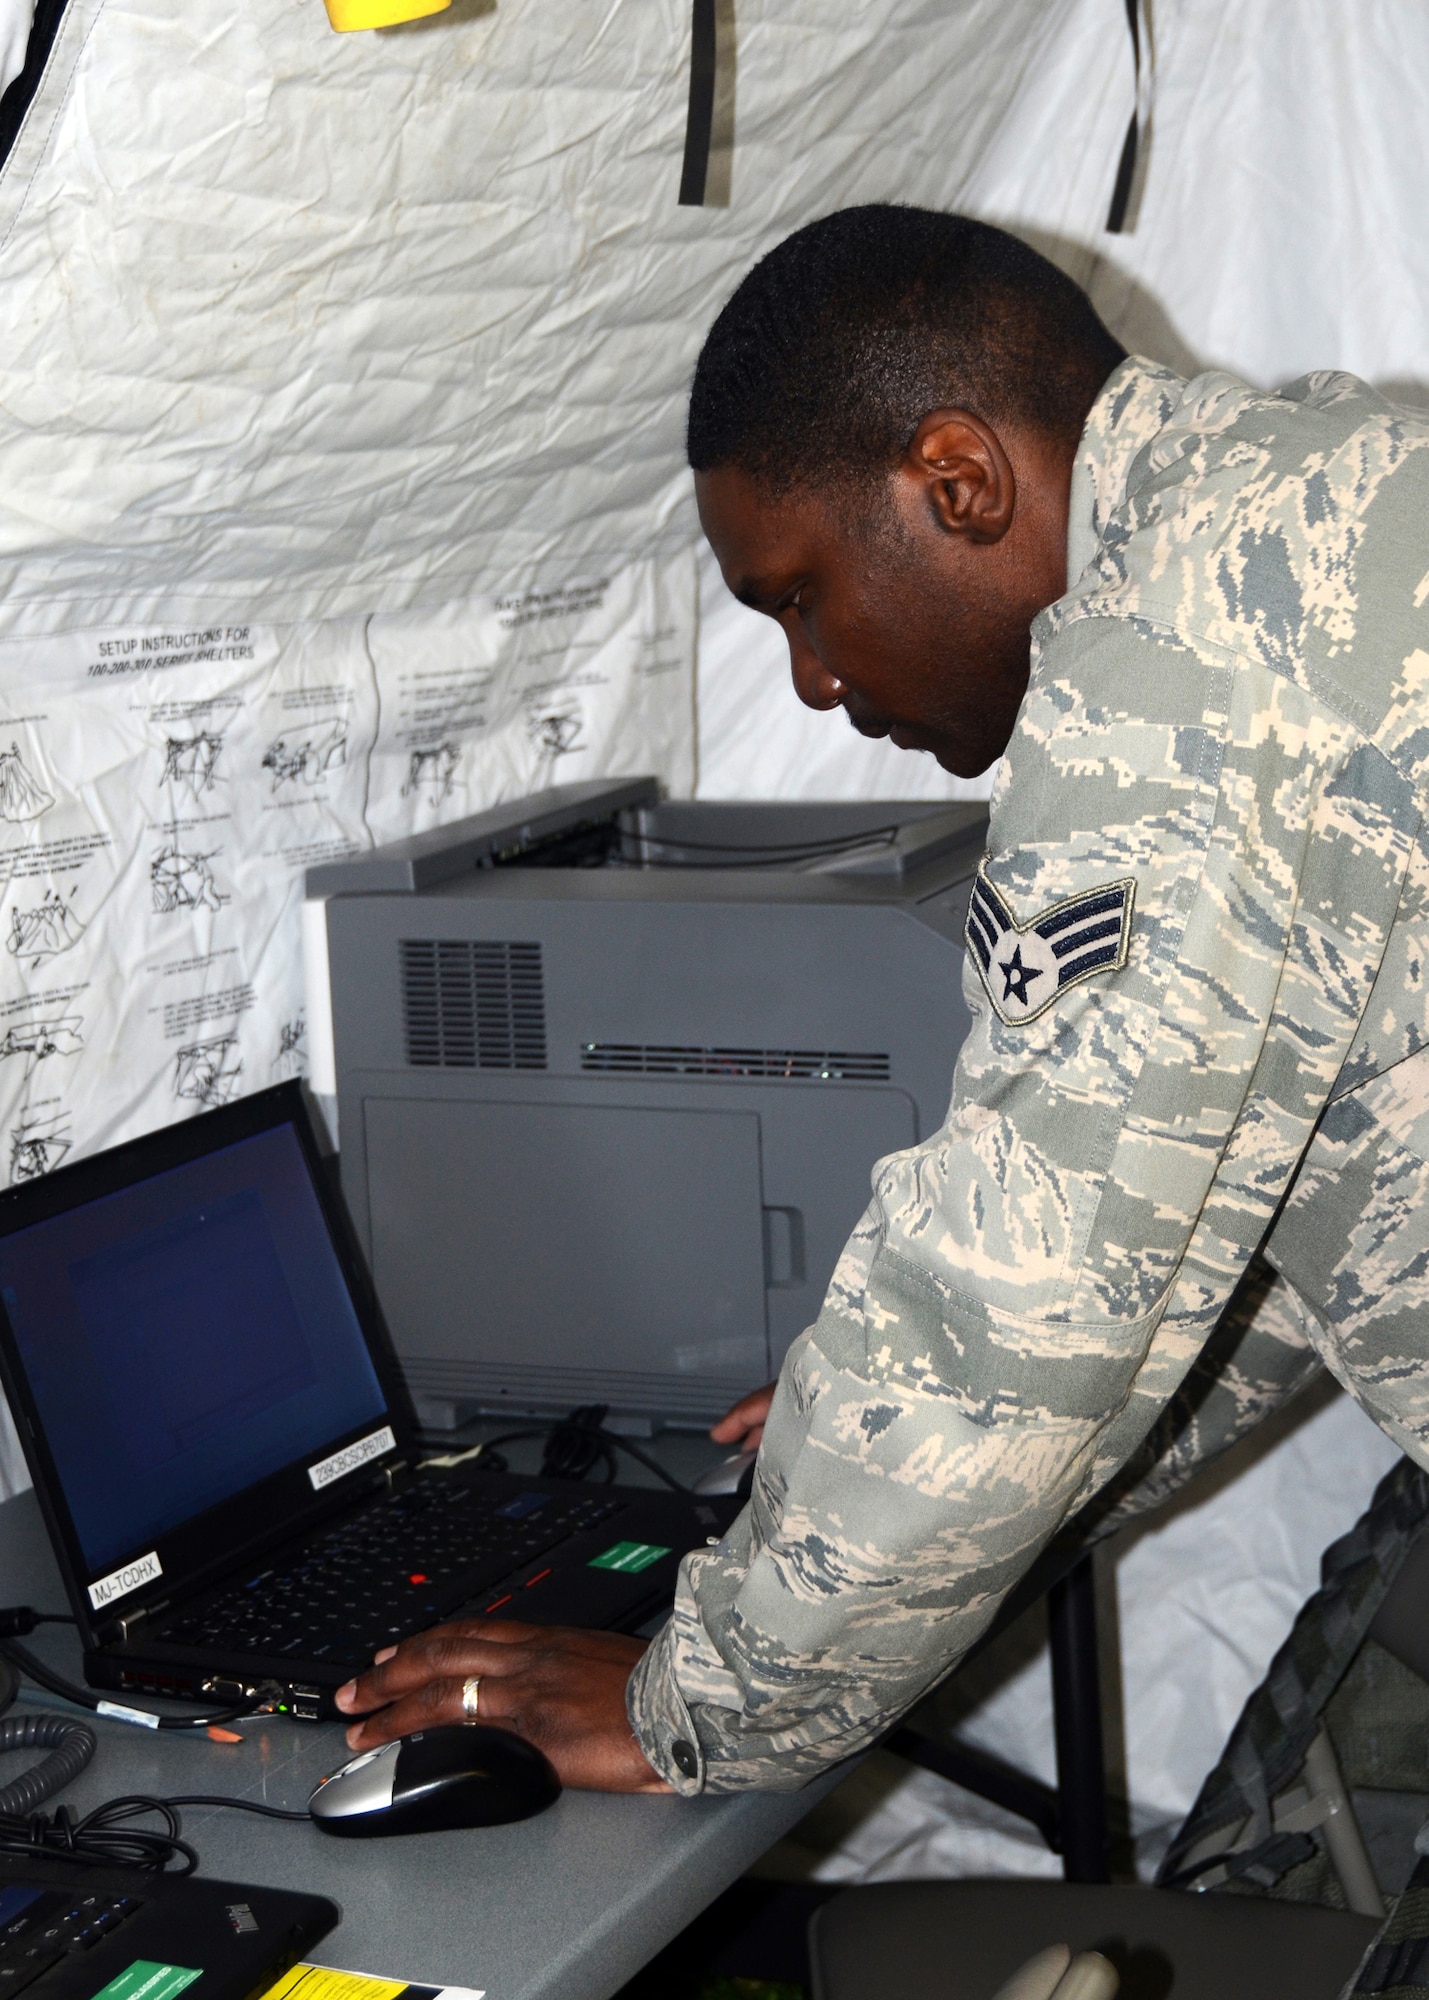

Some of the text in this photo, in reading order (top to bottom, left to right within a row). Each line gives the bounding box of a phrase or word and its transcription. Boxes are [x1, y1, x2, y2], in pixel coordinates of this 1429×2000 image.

[99, 627, 250, 657] SETUP INSTRUCTIONS FOR
[153, 652, 193, 669] SERIES
[194, 645, 255, 662] SHELTERS
[94, 1558, 157, 1604] MJ-TCDHX
